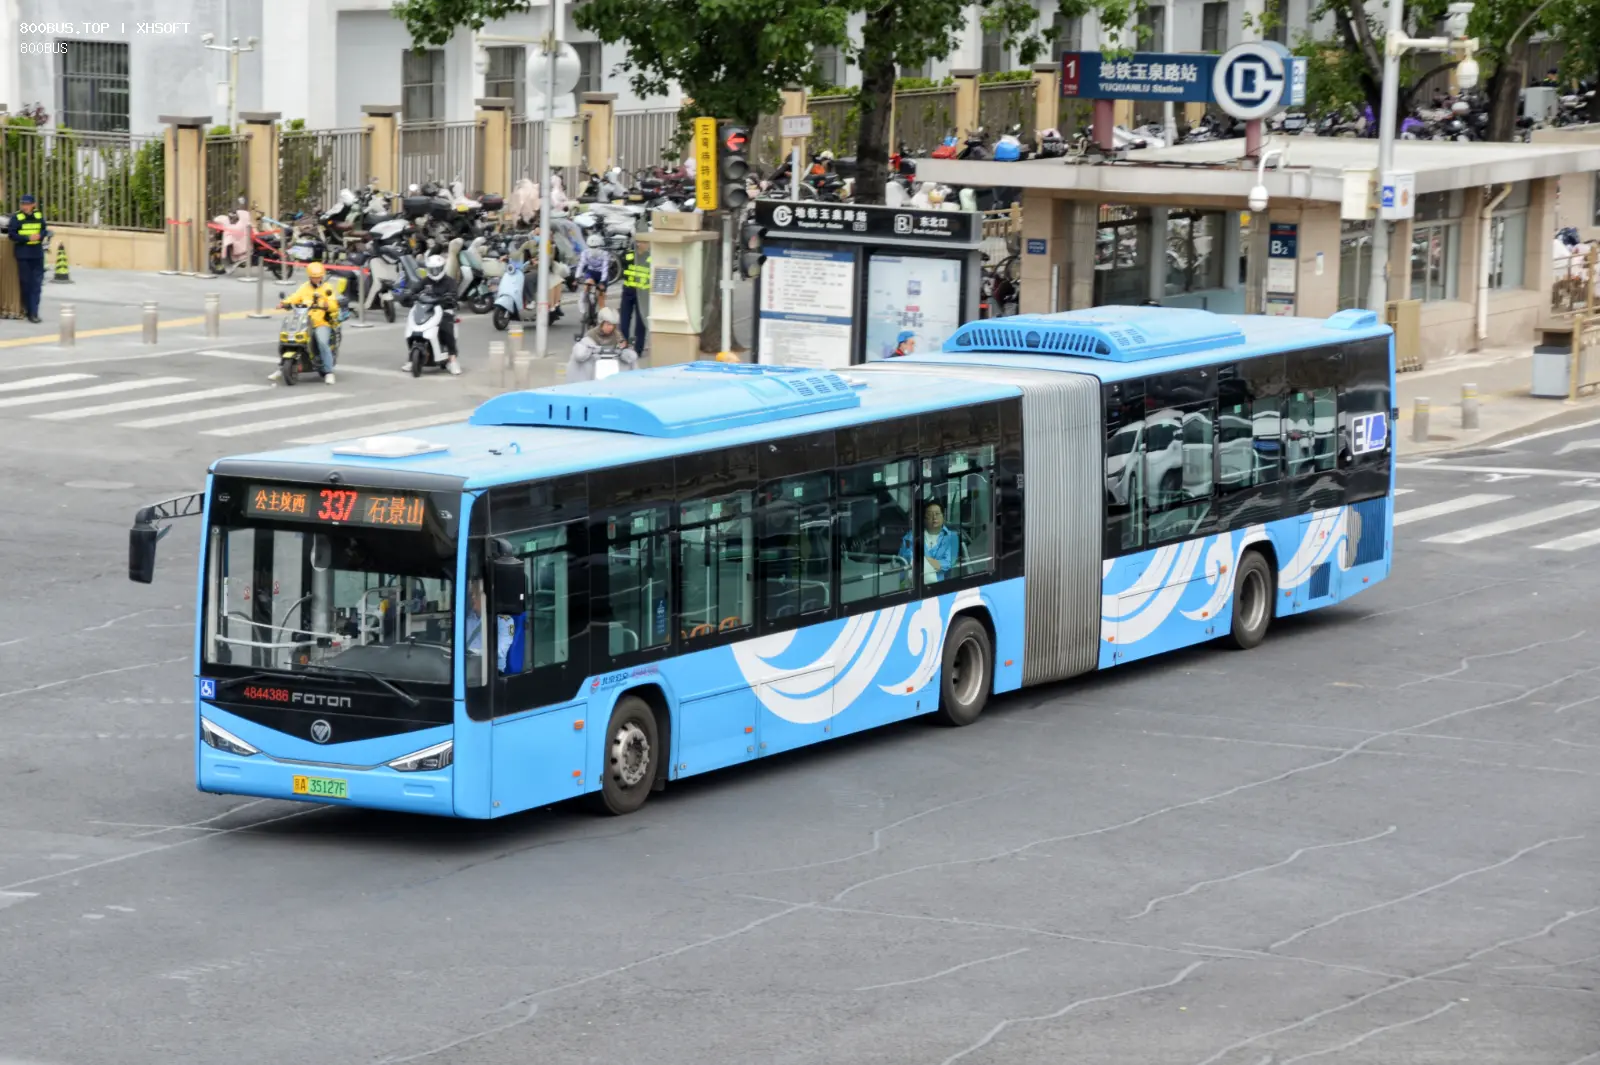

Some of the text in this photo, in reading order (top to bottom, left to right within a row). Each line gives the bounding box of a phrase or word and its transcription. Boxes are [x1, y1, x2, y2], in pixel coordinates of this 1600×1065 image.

[1066, 60, 1076, 79] 1
[1099, 61, 1198, 83] 地铁玉泉路站
[255, 489, 307, 513] 公主坟西
[318, 489, 358, 521] 337
[367, 496, 425, 526] 石景山
[244, 687, 289, 701] 4844386
[291, 692, 352, 708] FOTON
